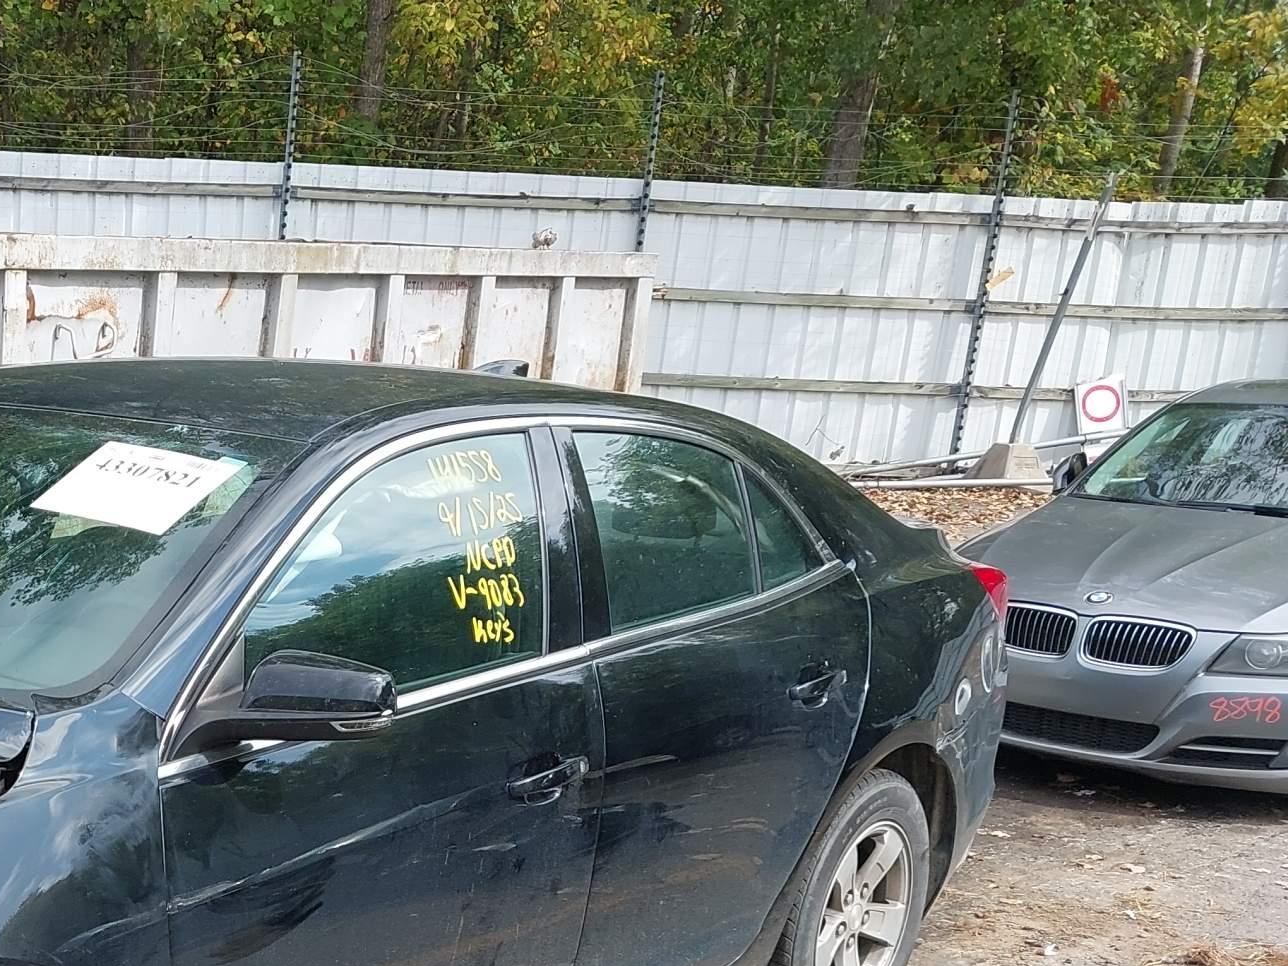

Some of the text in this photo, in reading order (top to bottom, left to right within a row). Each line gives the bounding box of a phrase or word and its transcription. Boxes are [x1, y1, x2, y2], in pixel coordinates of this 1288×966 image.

[96, 459, 200, 488] 43307821
[467, 536, 515, 574] NCPD
[447, 574, 524, 610] V-9083
[1209, 697, 1281, 723] 8898
